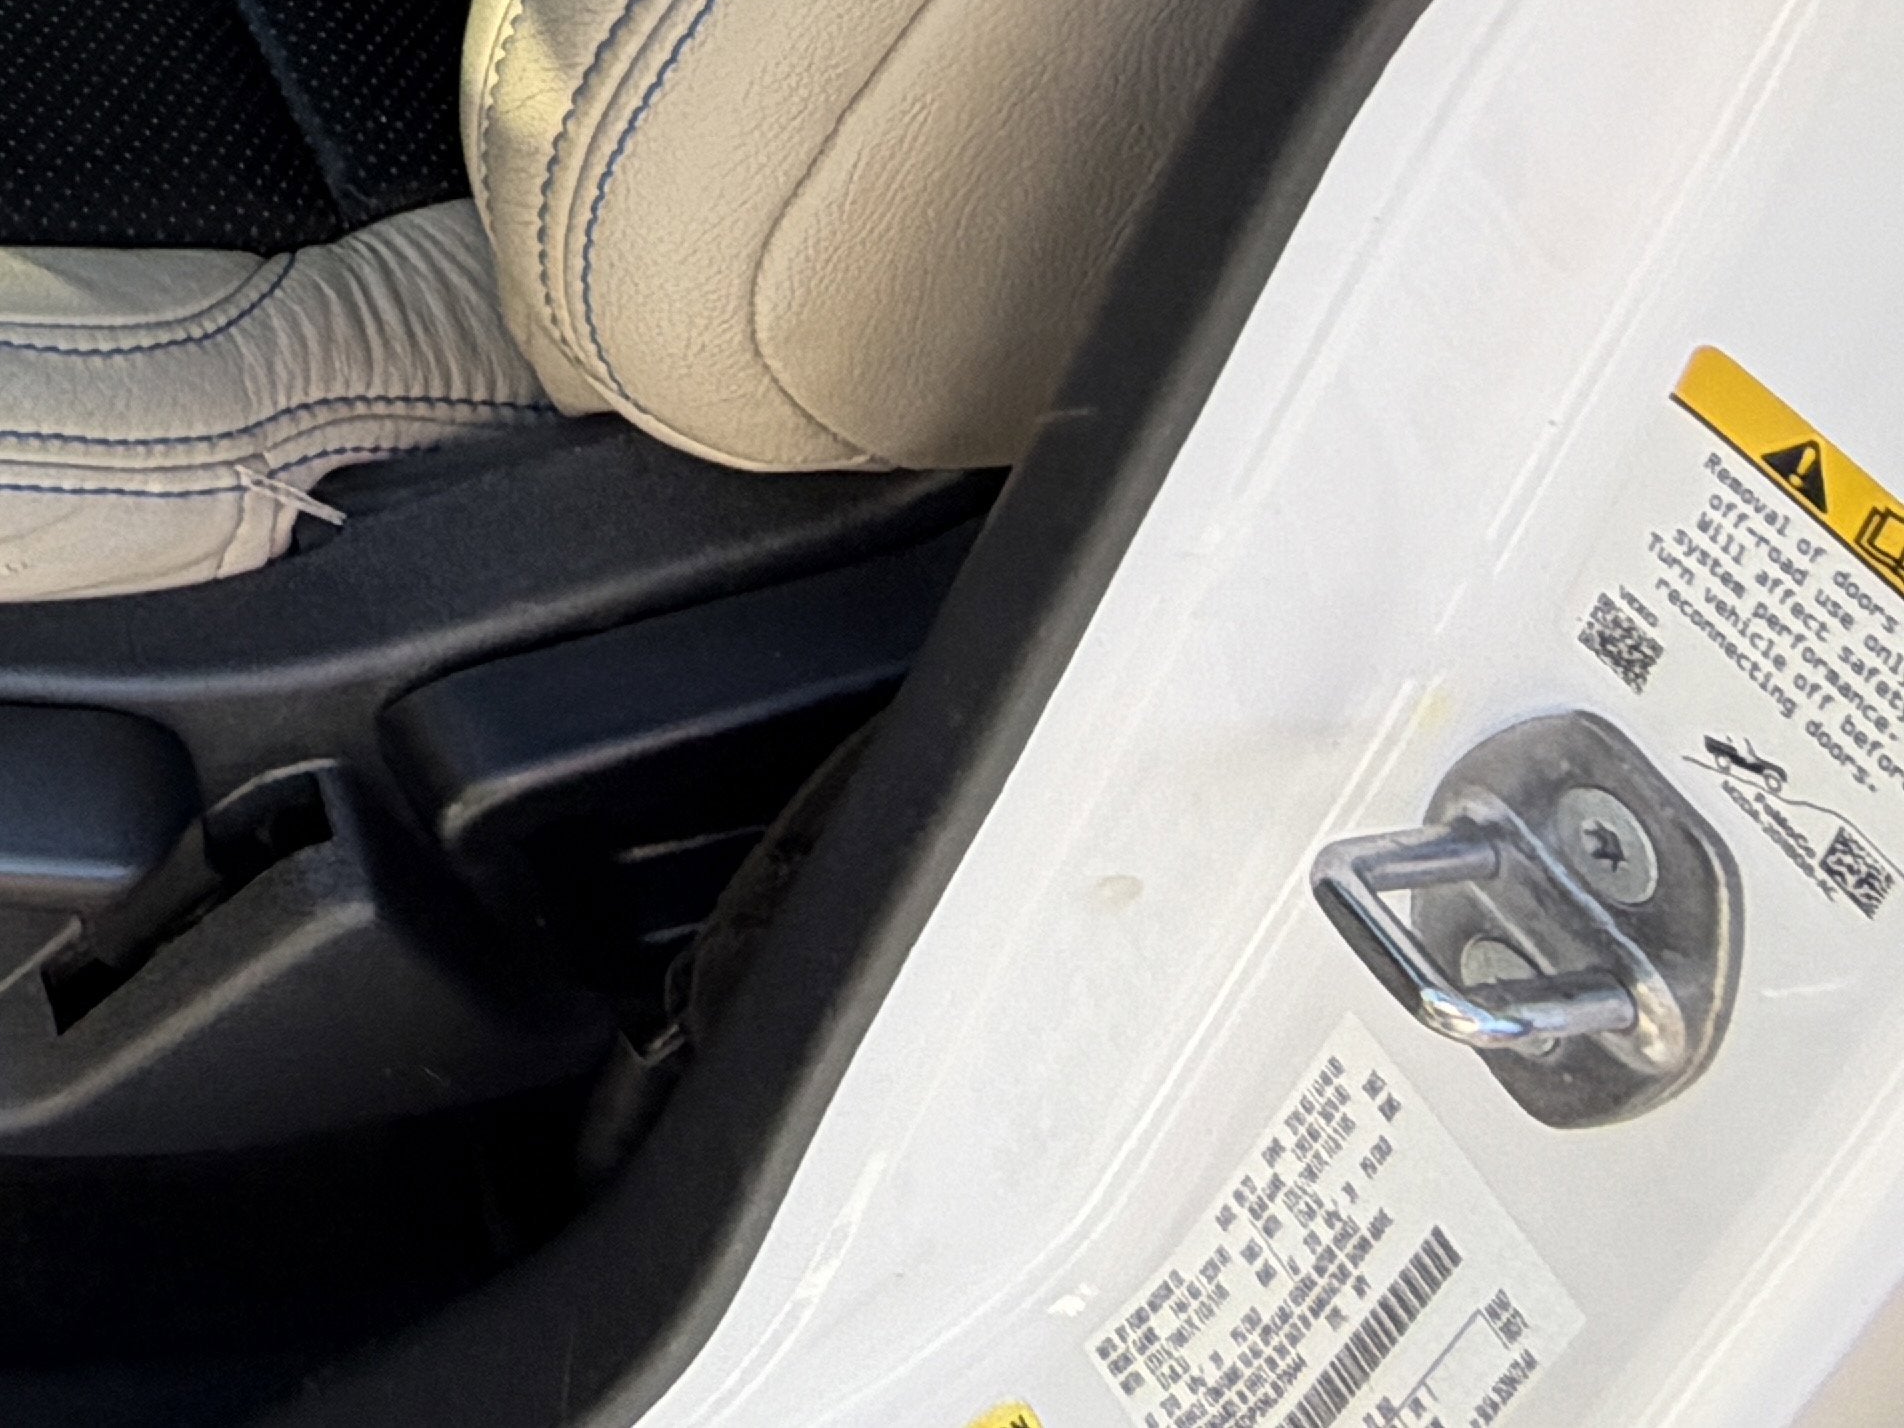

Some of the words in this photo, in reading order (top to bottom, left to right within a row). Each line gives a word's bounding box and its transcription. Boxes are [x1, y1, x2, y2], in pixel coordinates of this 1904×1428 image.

[1673, 528, 1747, 599] system
[1752, 601, 1899, 741] performance.
[1697, 511, 1745, 565] Will
[1755, 569, 1829, 642] affect
[1837, 645, 1904, 722] safet
[1704, 452, 1791, 537] Removal
[1796, 538, 1828, 563] of
[1833, 570, 1899, 634] doors
[1709, 493, 1809, 586] off-road
[1814, 588, 1854, 630] use
[1864, 634, 1904, 687] onl
[1648, 531, 1695, 585] Turn
[1704, 587, 1787, 672] vehicle
[1793, 673, 1835, 710] off
[1840, 713, 1904, 791] befor
[1655, 577, 1797, 719] reconnecting
[1805, 719, 1878, 792] doors.
